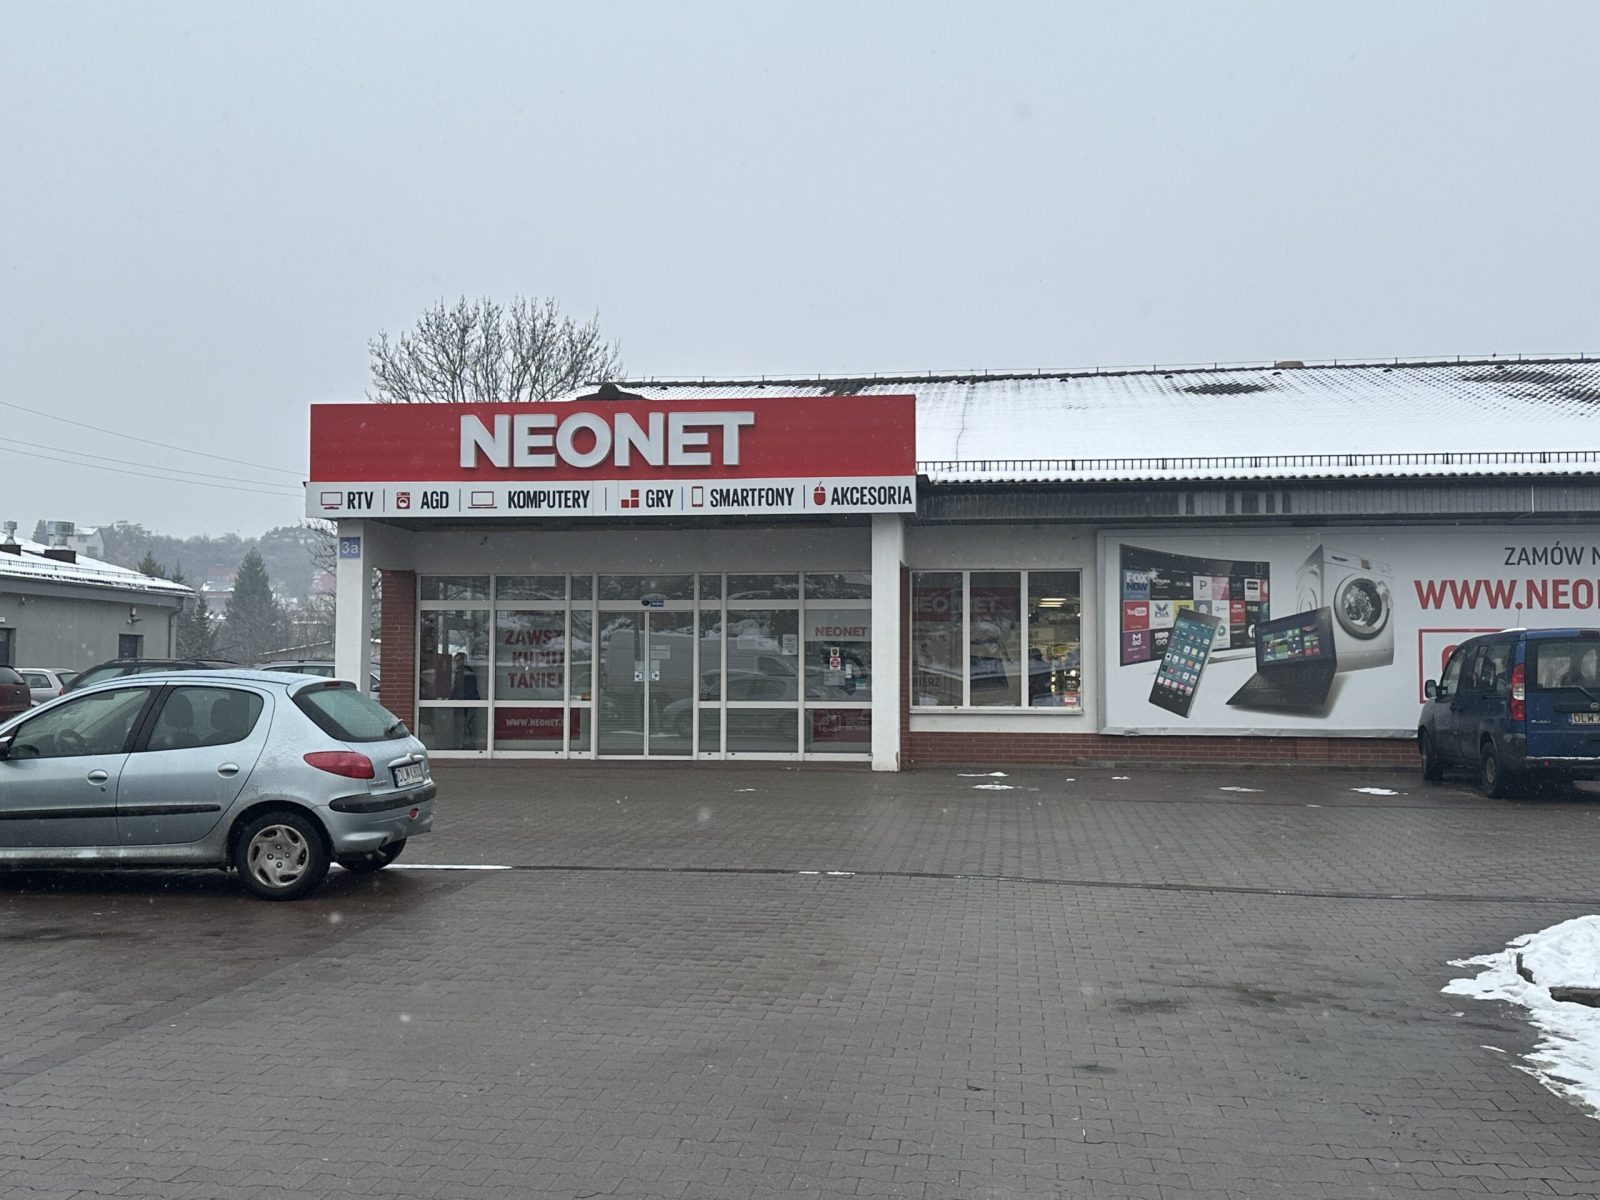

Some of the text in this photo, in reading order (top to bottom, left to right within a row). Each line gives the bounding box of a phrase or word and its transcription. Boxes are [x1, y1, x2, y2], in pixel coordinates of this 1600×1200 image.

[459, 411, 755, 469] NEONET
[347, 485, 912, 510] RTV AGD KOMPUTERY GRY SMARTFONY AKCESORIA
[341, 541, 359, 554] 3a
[1503, 541, 1585, 566] ZAMÓW
[1126, 572, 1149, 583] FOX
[1126, 583, 1148, 591] NOW
[1413, 579, 1600, 610] WWW.NEO
[815, 626, 868, 637] NEONET
[507, 672, 563, 688] TANIEJ
[506, 718, 565, 727] WWW.NEONET.
[1573, 713, 1594, 723] DLW
